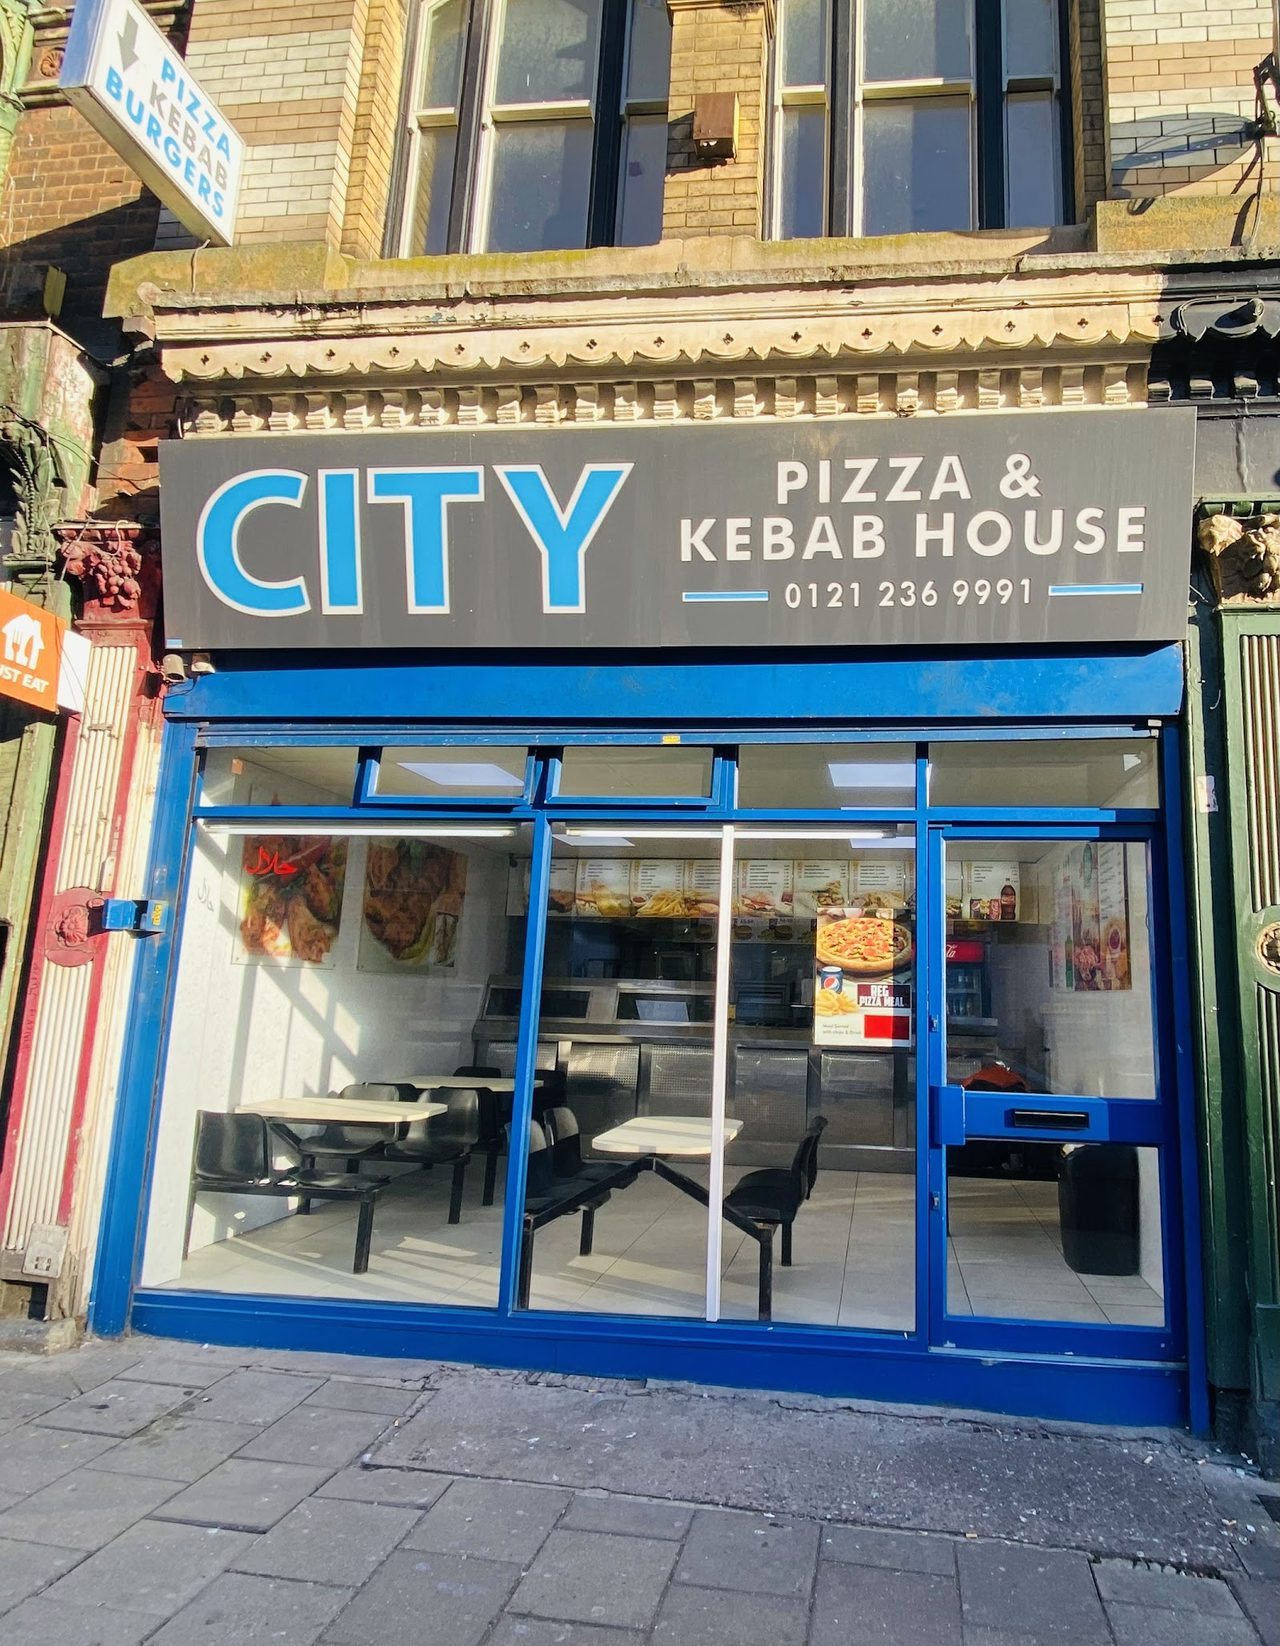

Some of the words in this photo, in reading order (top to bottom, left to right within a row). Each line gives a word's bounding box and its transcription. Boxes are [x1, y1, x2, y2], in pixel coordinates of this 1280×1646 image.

[149, 80, 227, 191] KEBAB
[161, 56, 231, 164] PIZZA
[105, 65, 224, 218] BURGERS
[776, 454, 972, 505] PIZZA
[999, 452, 1043, 500] &
[196, 462, 636, 617] CITY
[679, 513, 887, 562] KEBAB
[914, 506, 1147, 558] HOUSE
[785, 582, 860, 609] 0121
[878, 580, 939, 607] 236
[952, 578, 1032, 606] 9991
[22, 673, 49, 693] EAT
[243, 846, 298, 876] حلال
[860, 996, 882, 1007] PIZZA
[883, 996, 905, 1007] MEAL
[870, 985, 889, 997] REG
